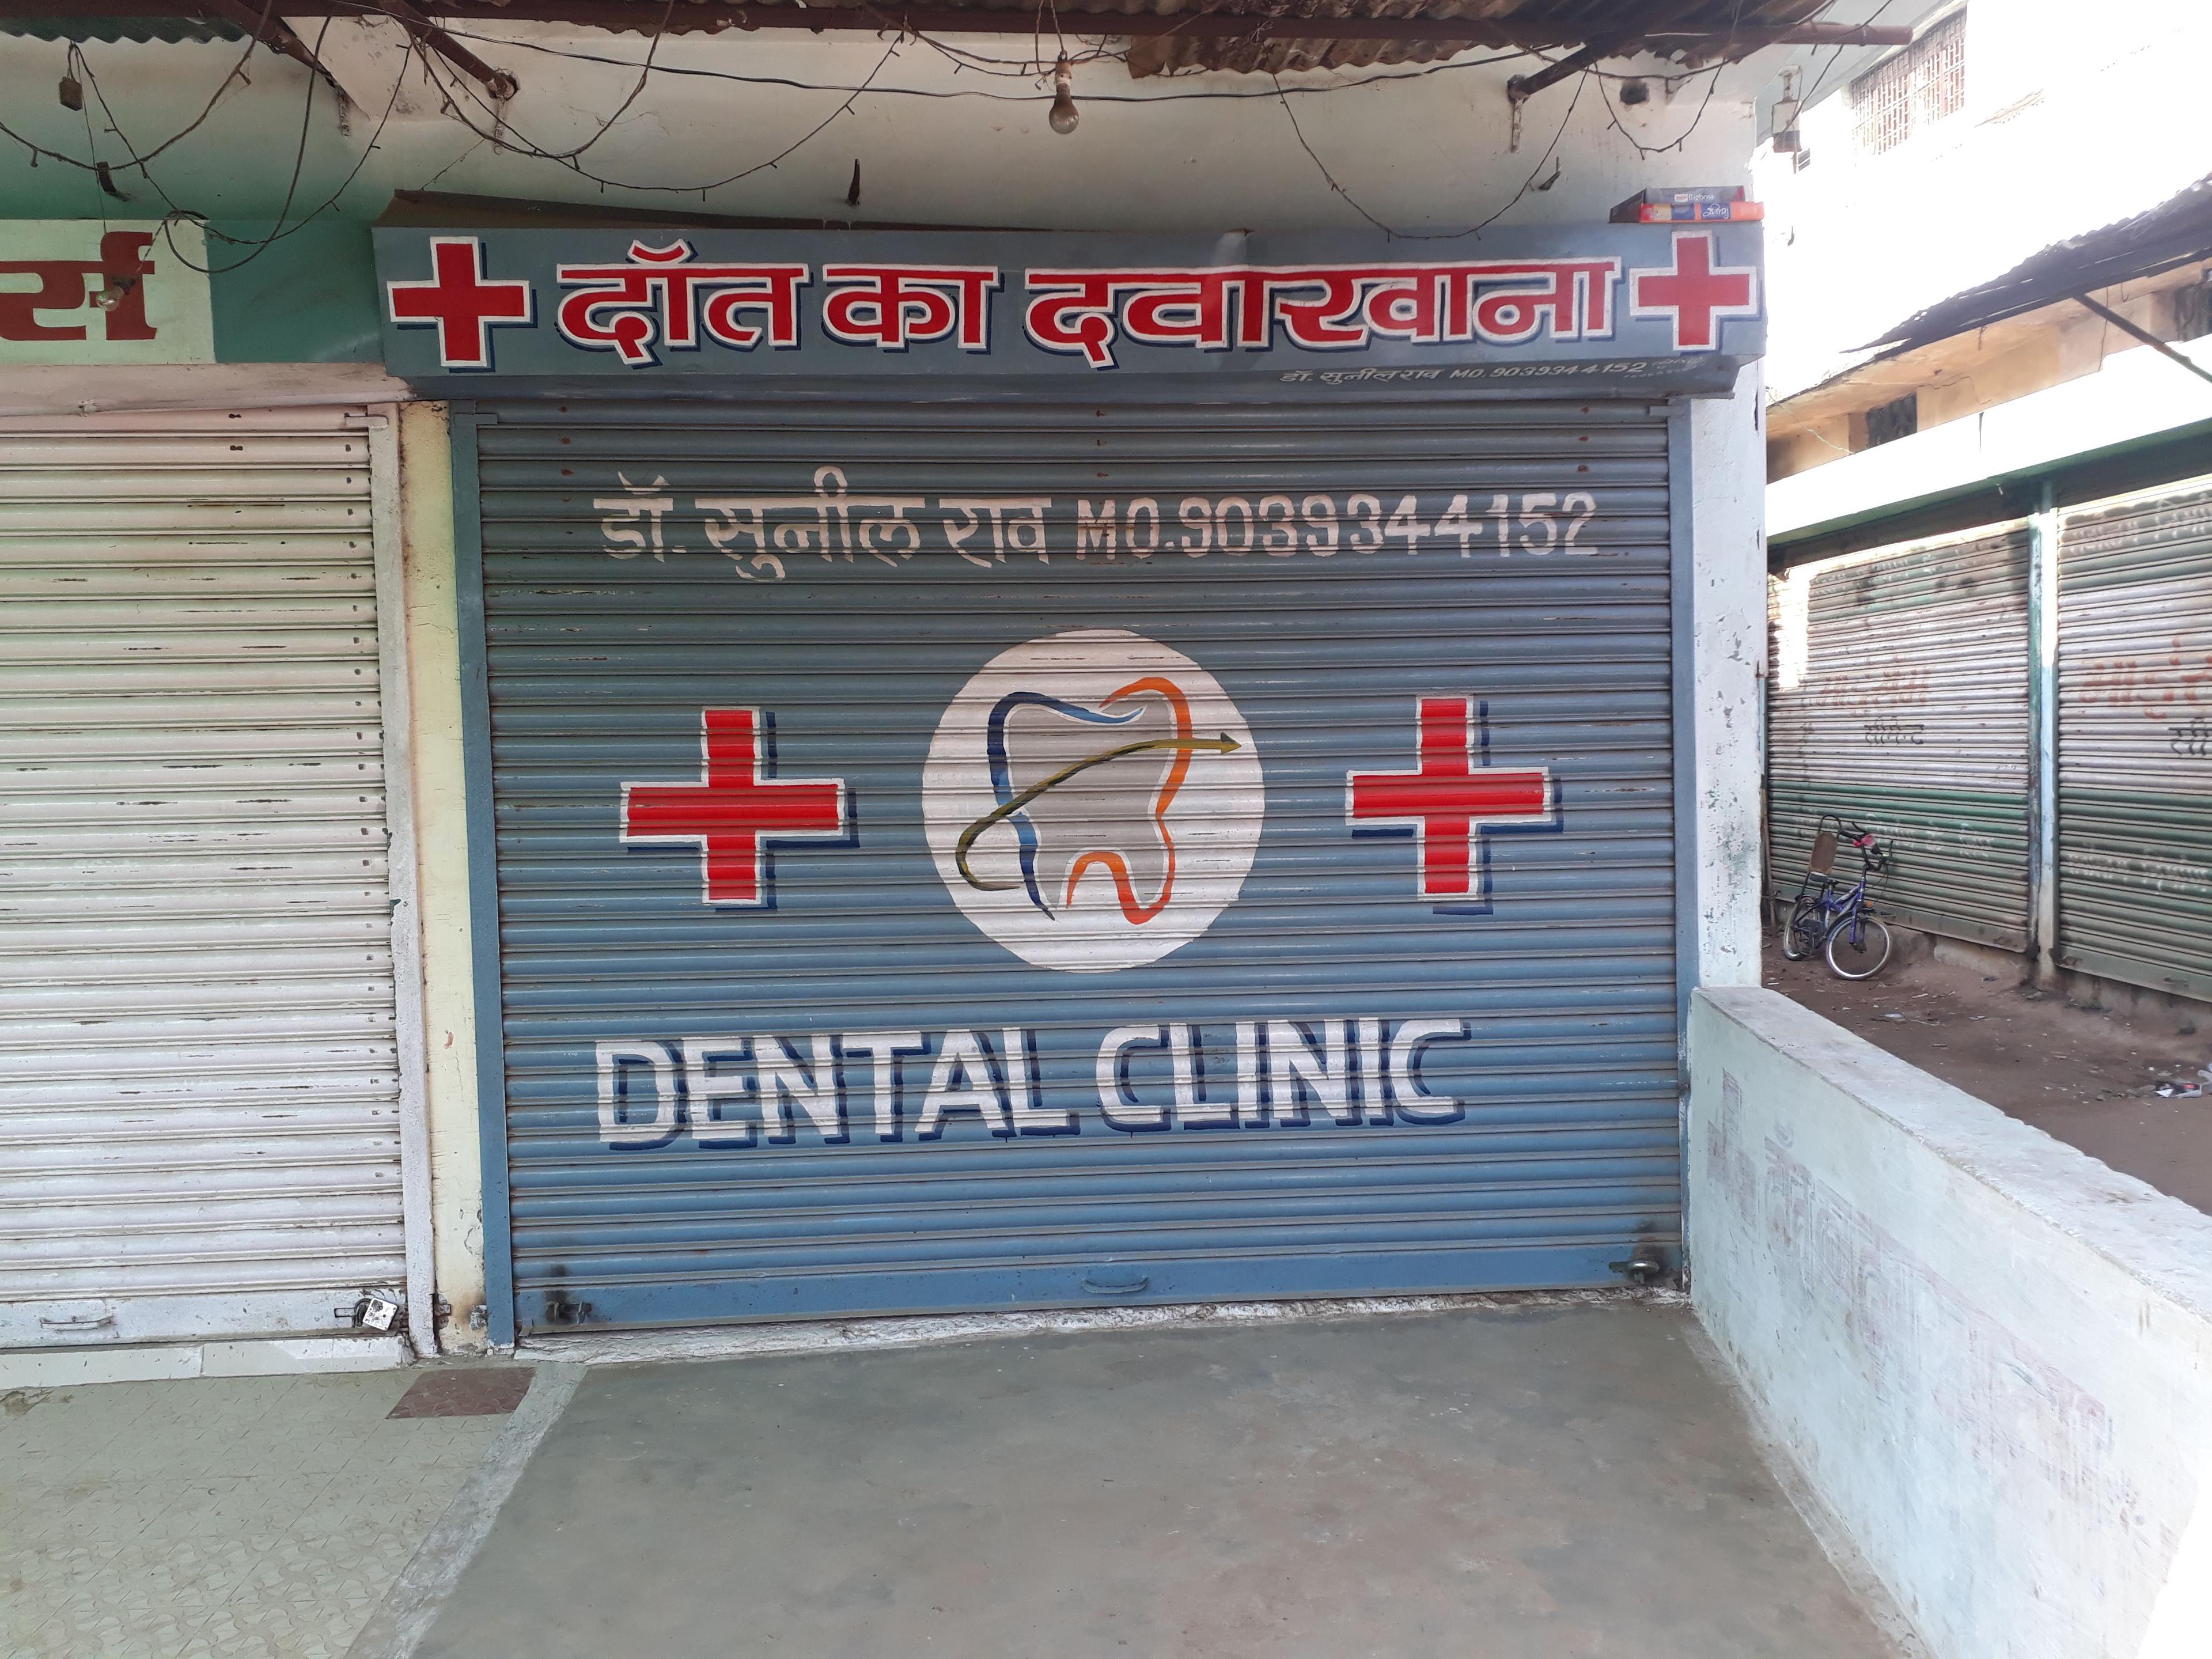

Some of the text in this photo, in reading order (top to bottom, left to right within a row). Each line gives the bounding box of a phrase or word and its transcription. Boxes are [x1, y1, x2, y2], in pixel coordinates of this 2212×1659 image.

[823, 263, 1003, 354] का
[1022, 256, 1624, 369] दवाखाना
[593, 471, 686, 562] डॉ.
[695, 466, 925, 581] सुनील
[940, 498, 1051, 568] राव
[596, 1017, 1471, 1150] DENTAL CLINIC
